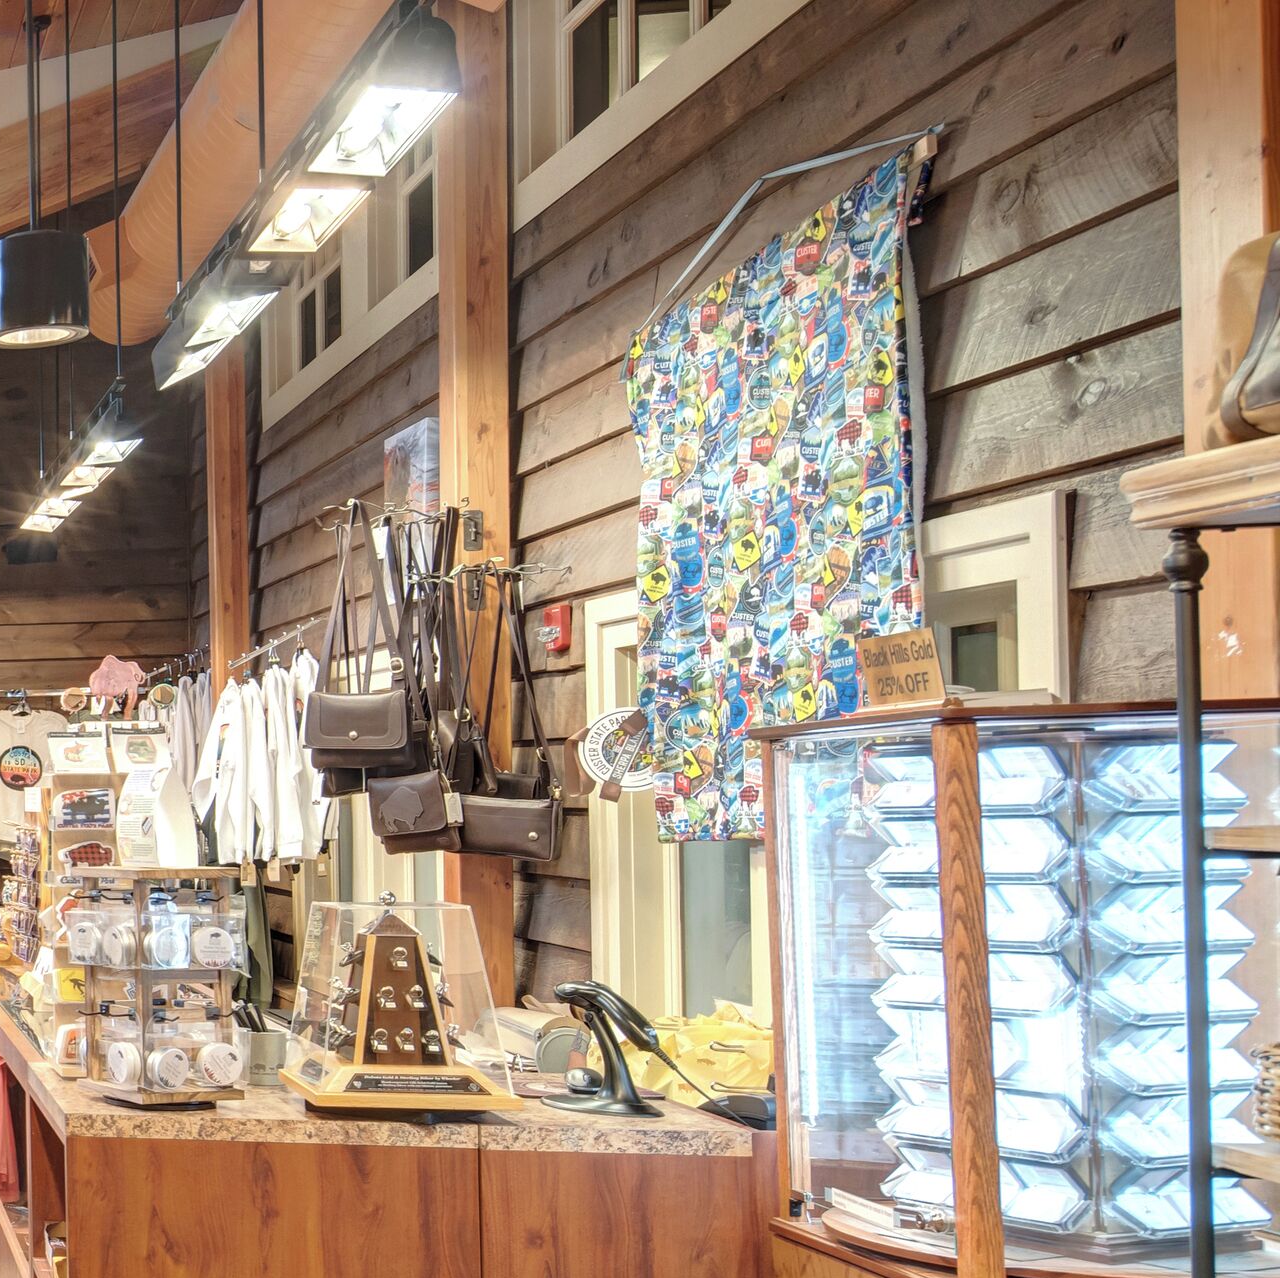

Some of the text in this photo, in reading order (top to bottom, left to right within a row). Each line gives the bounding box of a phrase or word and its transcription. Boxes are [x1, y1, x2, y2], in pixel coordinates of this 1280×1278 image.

[796, 244, 818, 258] CUSTER
[853, 241, 871, 252] CUSTE
[801, 446, 821, 455] CUSTE
[672, 536, 696, 549] CUSTER
[732, 612, 755, 622] CUSTER
[863, 638, 934, 668] Black Hills Gold
[829, 656, 853, 668] CUSTER
[877, 671, 929, 697] 25% OFF
[588, 722, 610, 776] CUSTER STATE
[612, 753, 631, 780] SHERPA
